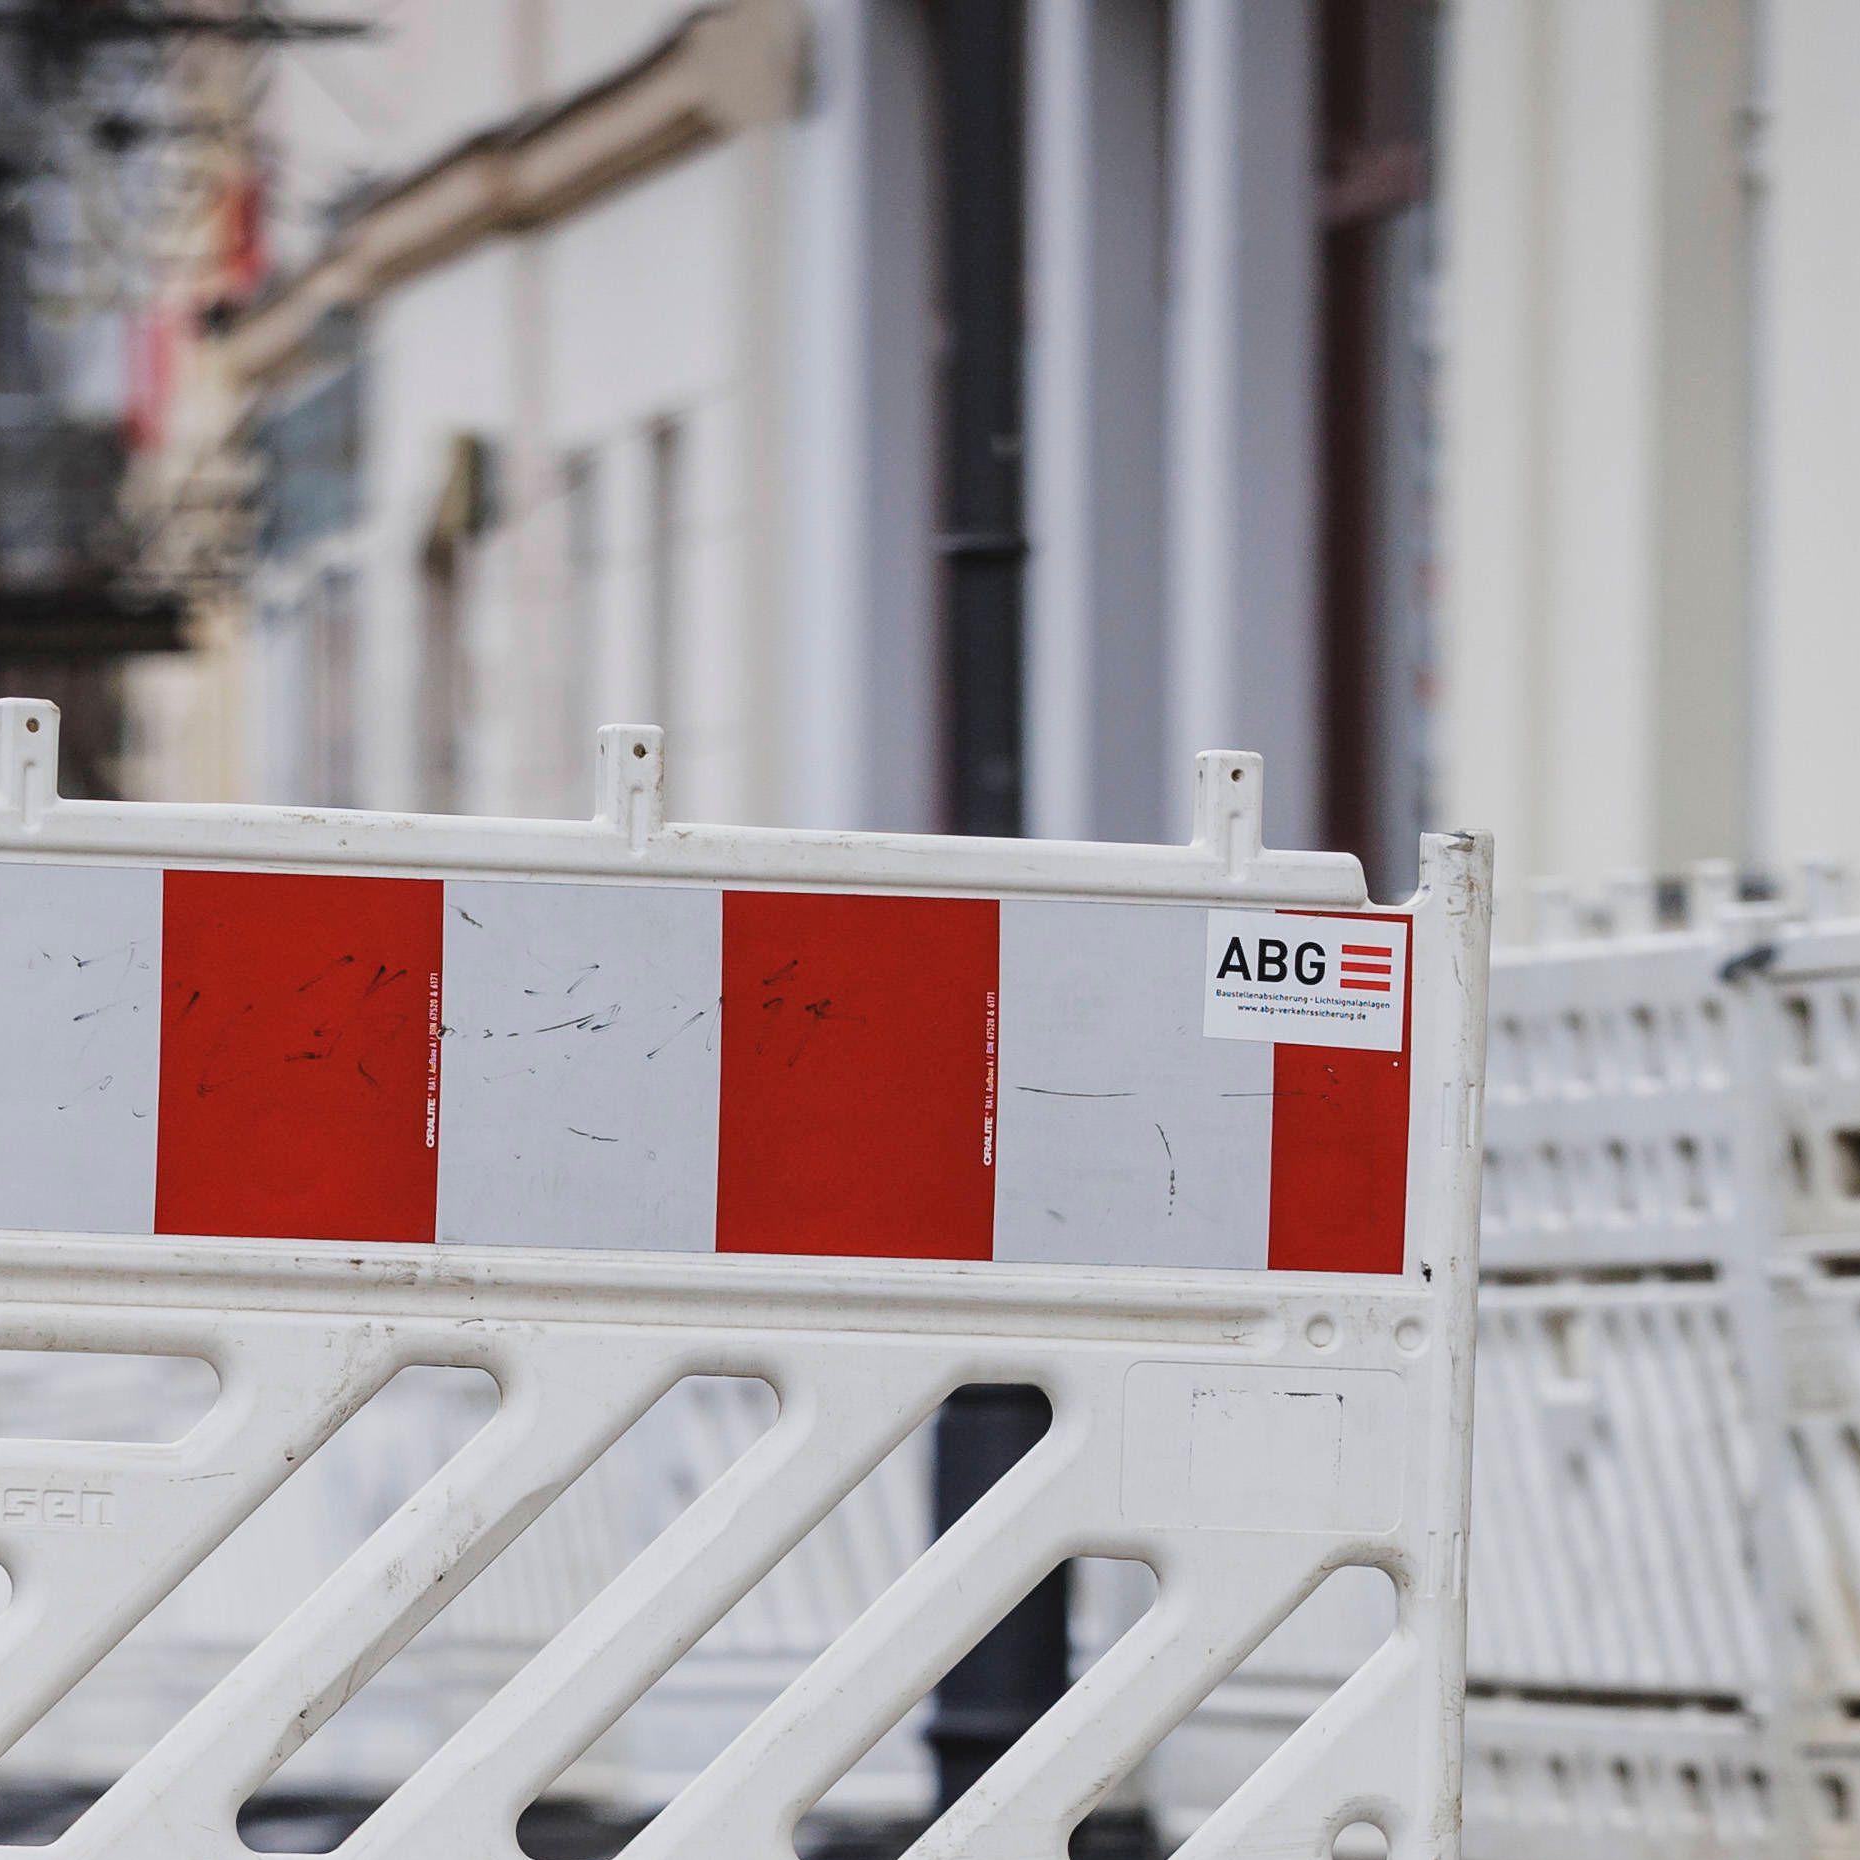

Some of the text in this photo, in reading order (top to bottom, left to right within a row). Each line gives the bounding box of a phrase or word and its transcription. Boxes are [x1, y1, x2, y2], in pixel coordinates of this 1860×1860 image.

[1216, 936, 1326, 986] ABG
[429, 972, 439, 990] 6171
[429, 990, 439, 998] &
[986, 991, 996, 1009] 6171
[1215, 988, 1391, 1010] Baustellenabsicherung Lichtsignalanlagen
[428, 998, 439, 1022] 67520
[986, 1009, 995, 1017] &
[1237, 1004, 1367, 1021] www.abg-verkehrssicherung.de
[986, 1017, 996, 1040] 67520
